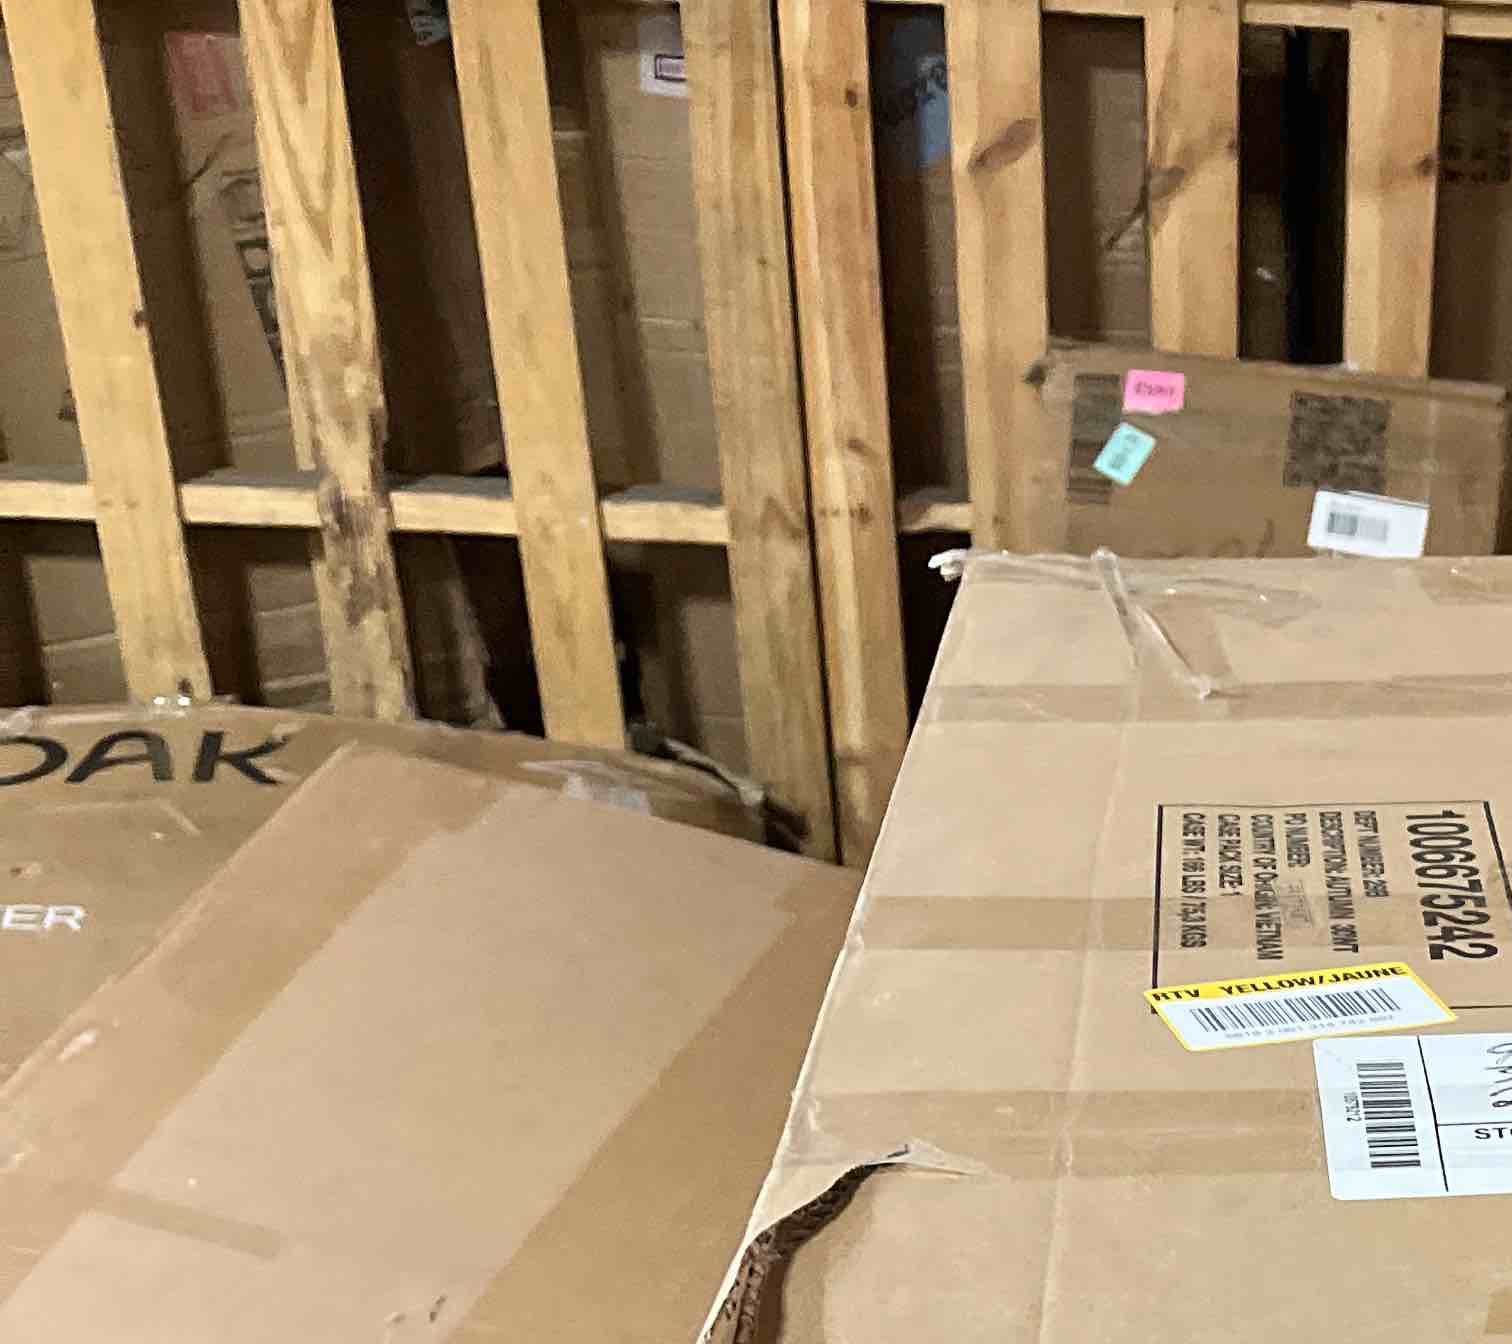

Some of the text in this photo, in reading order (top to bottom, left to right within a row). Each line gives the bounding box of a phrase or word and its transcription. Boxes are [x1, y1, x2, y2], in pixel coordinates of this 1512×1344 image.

[1182, 813, 1205, 837] CASE
[1217, 814, 1241, 837] CASE
[1250, 814, 1276, 855] COUNTRY
[1218, 839, 1241, 863] PACK
[1253, 857, 1276, 870] OF
[1181, 874, 1205, 894] LBS
[1406, 809, 1498, 960] 1006675242
[1325, 876, 1354, 920] AUTUMN
[0, 904, 88, 929] ER
[1181, 925, 1206, 948] KGS
[1256, 912, 1283, 960] VIETNAM
[1219, 966, 1407, 996] YELLOW/JAUNE
